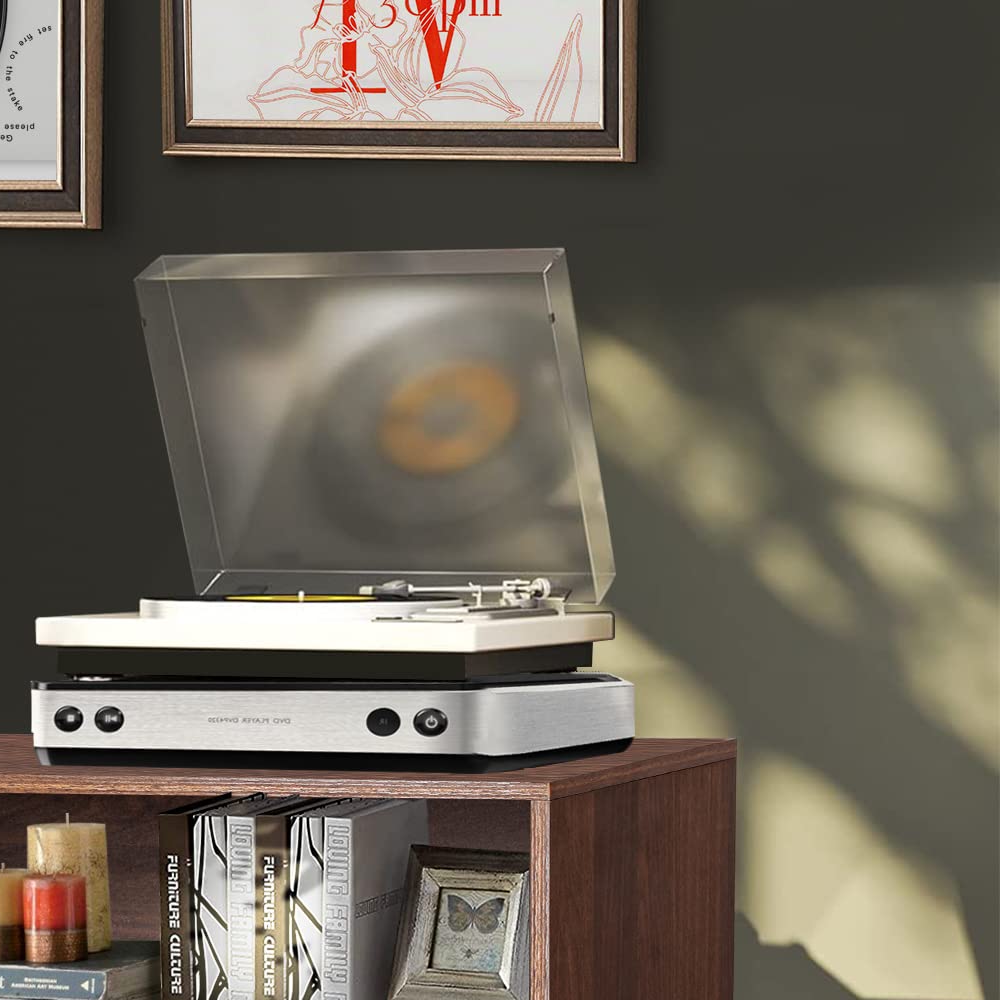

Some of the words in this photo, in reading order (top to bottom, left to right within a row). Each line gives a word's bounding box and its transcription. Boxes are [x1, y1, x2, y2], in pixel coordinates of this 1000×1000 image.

[37, 25, 52, 35] set
[18, 33, 34, 46] fire
[9, 50, 18, 60] to
[5, 65, 14, 82] the
[7, 87, 23, 112] stake
[4, 122, 35, 131] please
[324, 904, 349, 984] FAMILY
[169, 934, 182, 994] CULTURE
[263, 935, 275, 996] CULTURE
